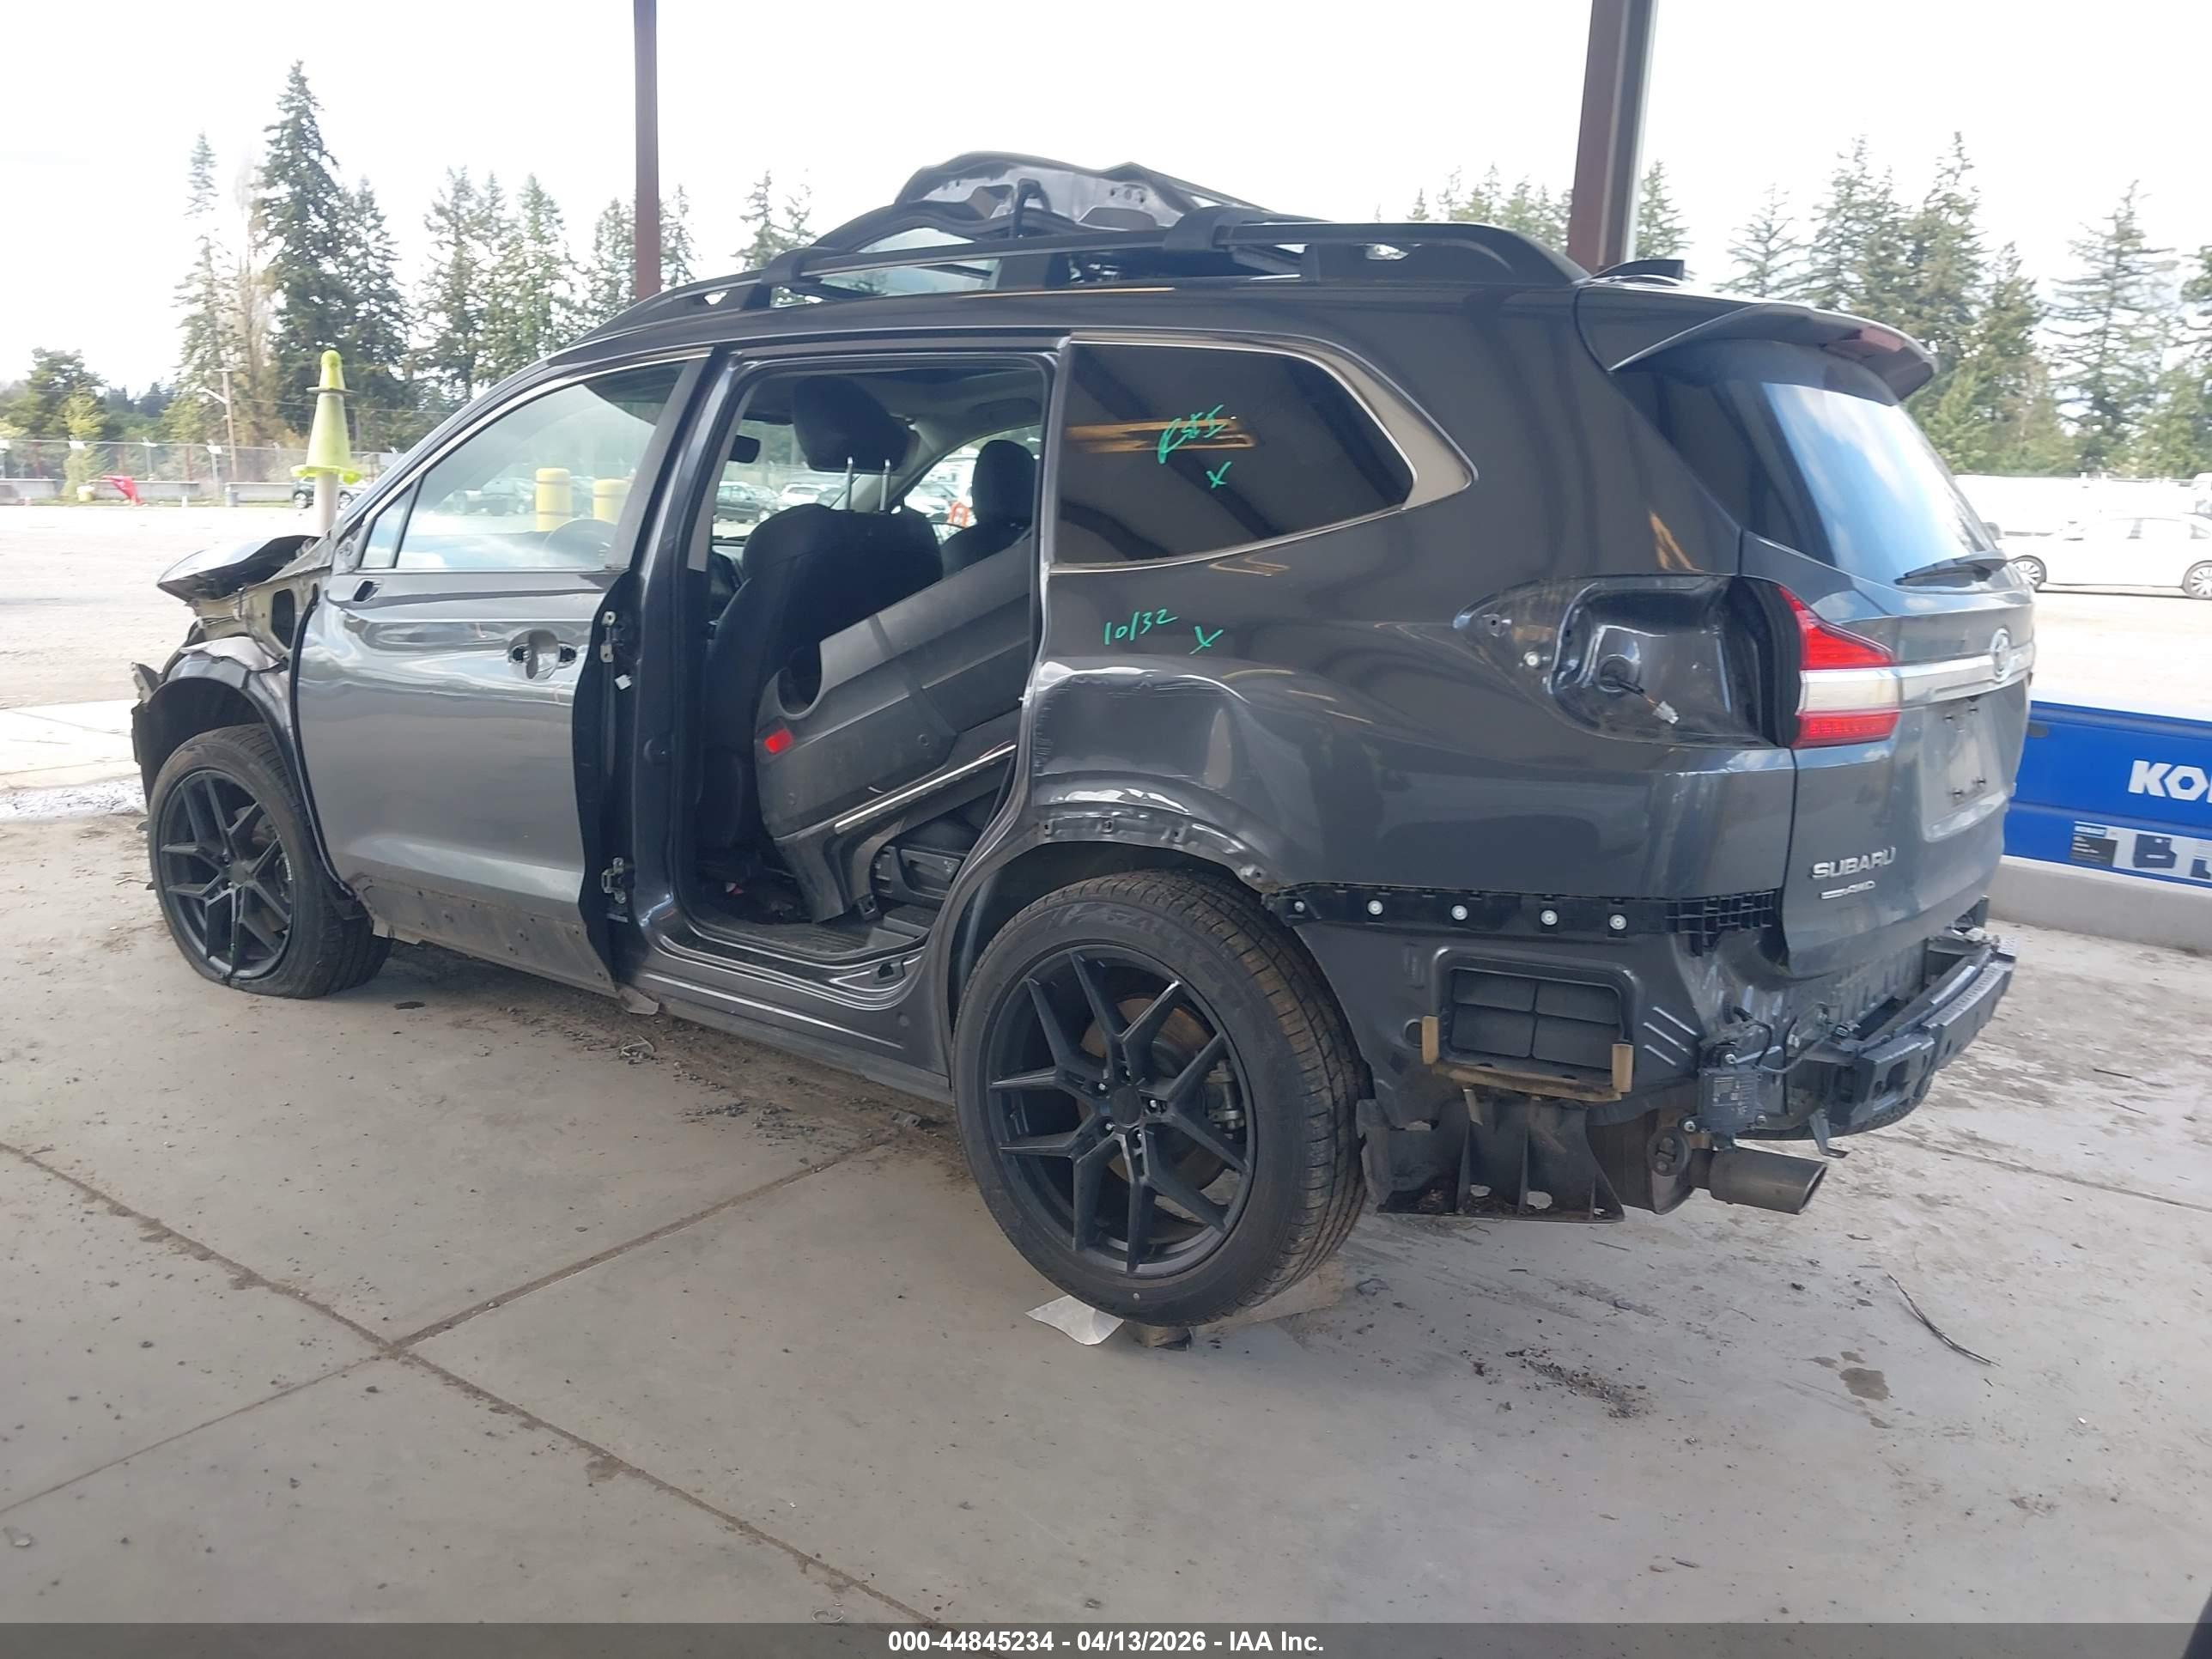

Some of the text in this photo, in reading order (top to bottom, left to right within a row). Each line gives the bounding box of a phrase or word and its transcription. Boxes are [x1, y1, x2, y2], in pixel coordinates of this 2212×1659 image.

[1103, 607, 1178, 647] 10/32
[2127, 759, 2212, 804] KO
[1812, 846, 1896, 879] SUBARU
